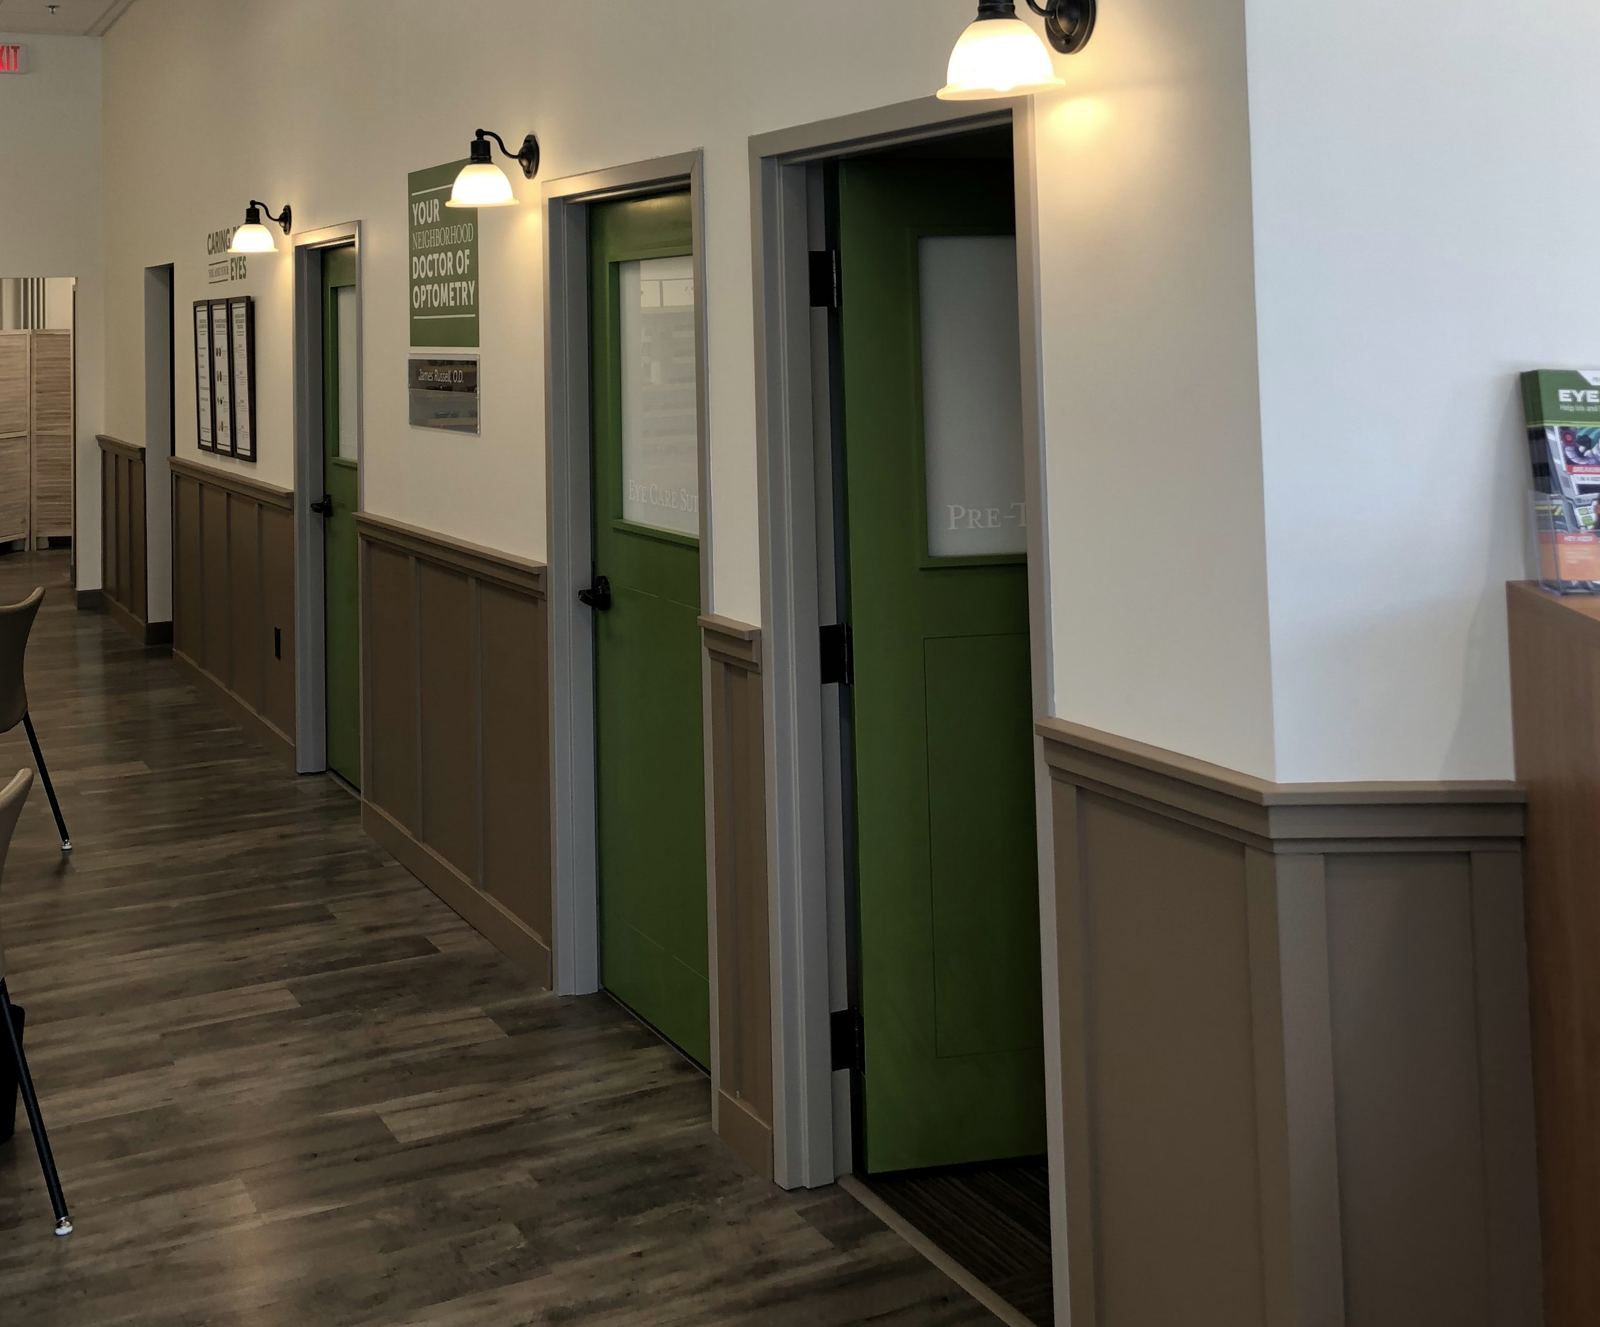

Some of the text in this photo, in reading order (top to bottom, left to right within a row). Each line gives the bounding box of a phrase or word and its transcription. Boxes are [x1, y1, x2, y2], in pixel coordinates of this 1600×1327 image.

[412, 198, 440, 226] YOUR
[207, 227, 230, 255] CARING
[412, 223, 474, 250] NEIGHBORHOOD
[230, 255, 247, 281] EYES
[412, 249, 470, 280] DOCTOR OF
[412, 280, 475, 309] OPTOMETRY
[418, 368, 433, 381] James
